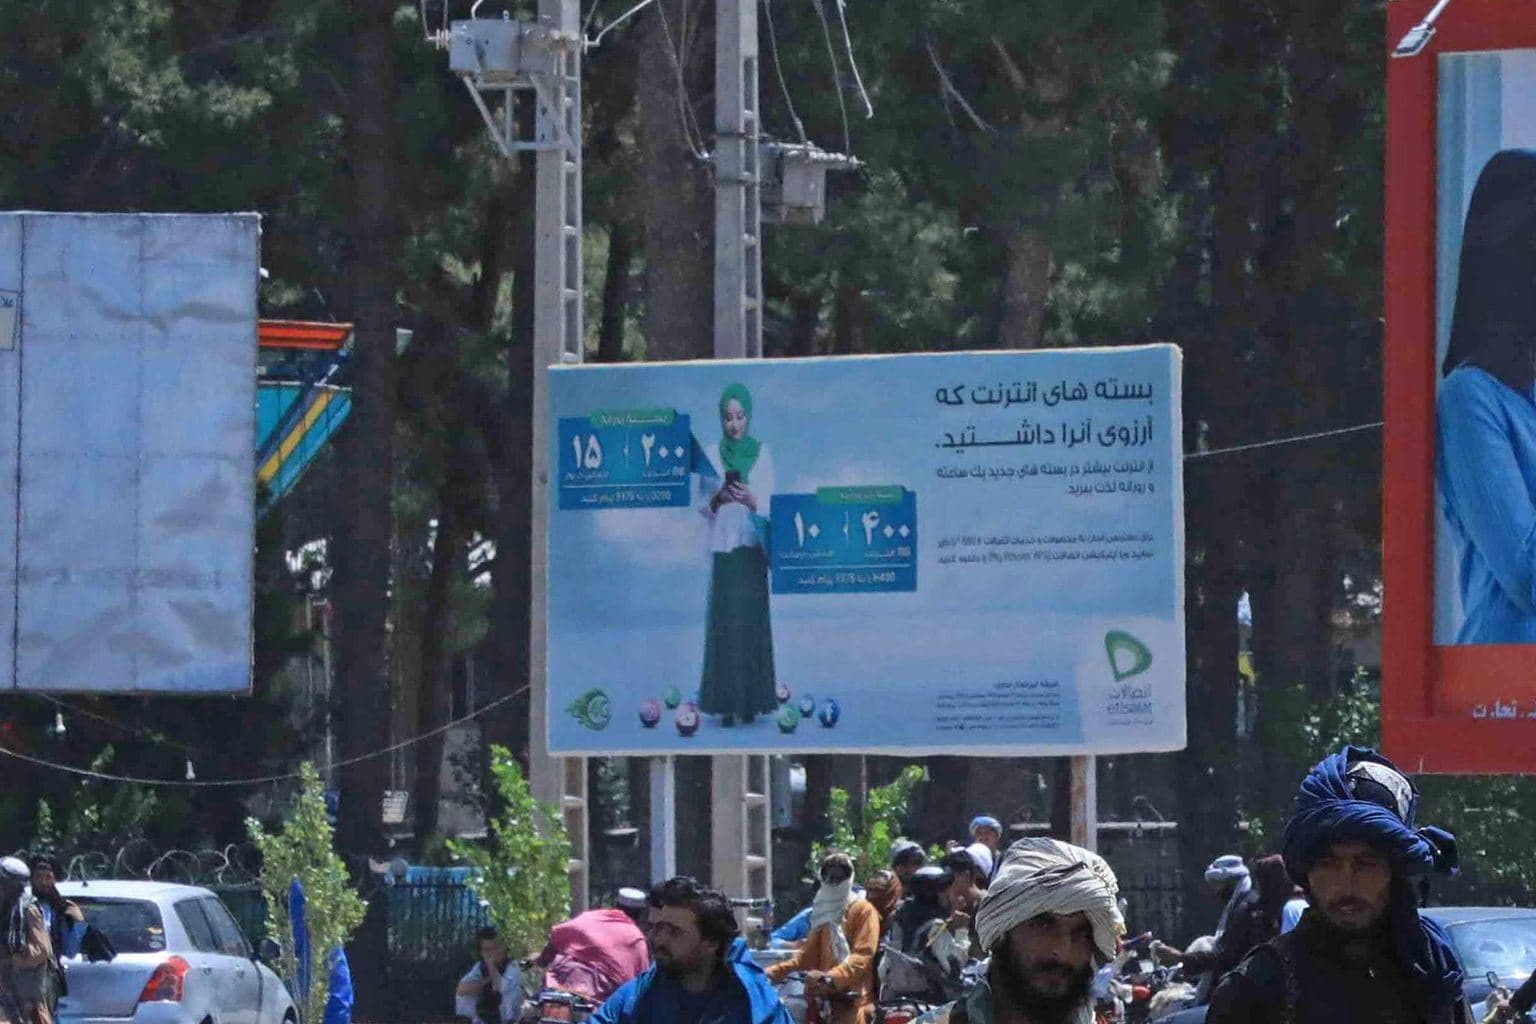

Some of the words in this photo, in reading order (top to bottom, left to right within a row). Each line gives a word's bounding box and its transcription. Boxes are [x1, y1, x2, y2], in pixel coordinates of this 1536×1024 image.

[936, 384, 965, 406] که
[971, 382, 1037, 408] انترنت
[1043, 380, 1087, 407] های
[1095, 377, 1153, 406] بسته
[1062, 418, 1092, 448] آنرا
[1097, 415, 1153, 448] آرزوی
[573, 434, 602, 469] ۱۵
[641, 432, 685, 467] ۲۰۰
[794, 511, 820, 548] ۱۰
